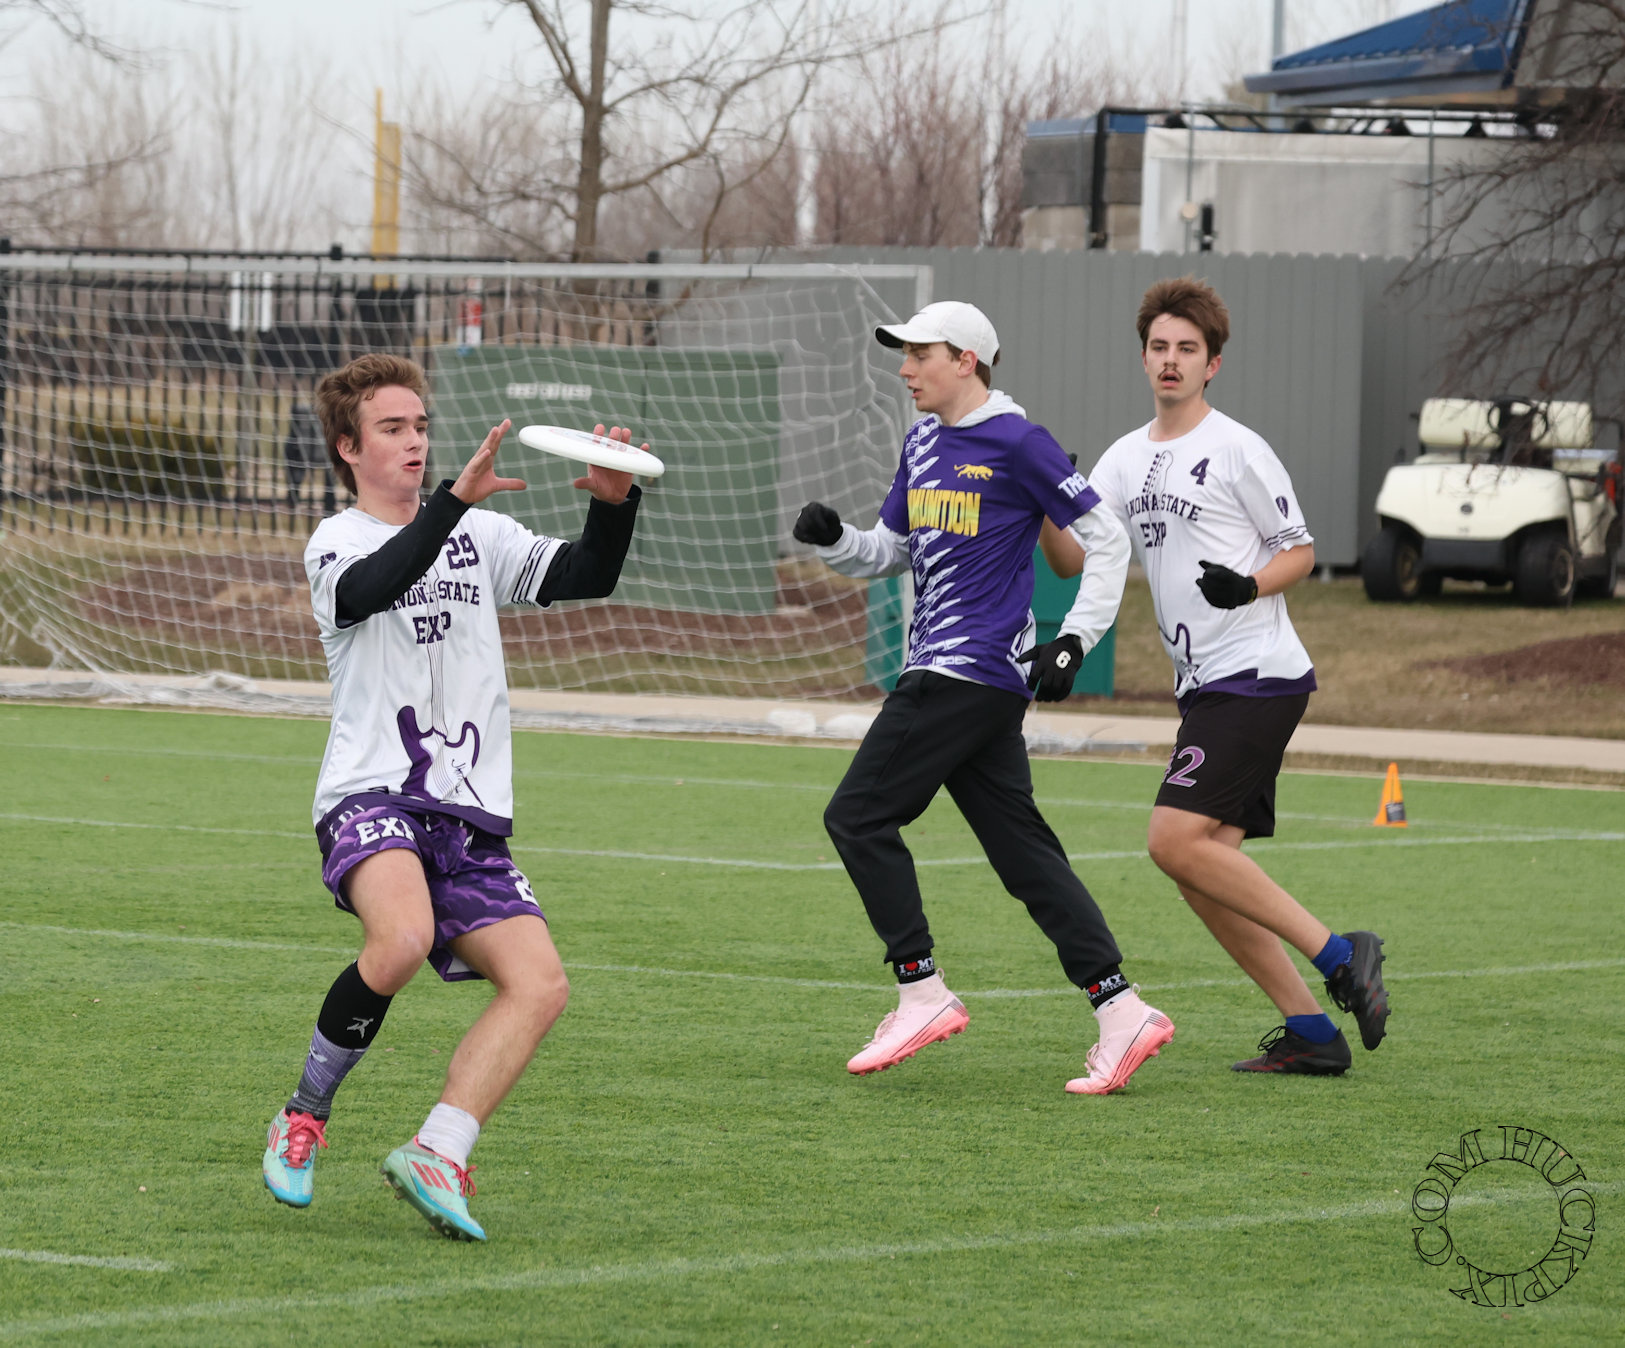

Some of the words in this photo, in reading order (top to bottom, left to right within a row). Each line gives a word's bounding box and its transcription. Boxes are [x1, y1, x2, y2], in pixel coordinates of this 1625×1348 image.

[1190, 457, 1210, 485] 4
[1160, 493, 1203, 521] STATE
[1140, 521, 1167, 547] EXP
[442, 533, 479, 570] 29
[437, 580, 480, 606] STATE
[412, 611, 452, 644] EXP
[899, 963, 906, 974] I
[1098, 973, 1122, 991] MY
